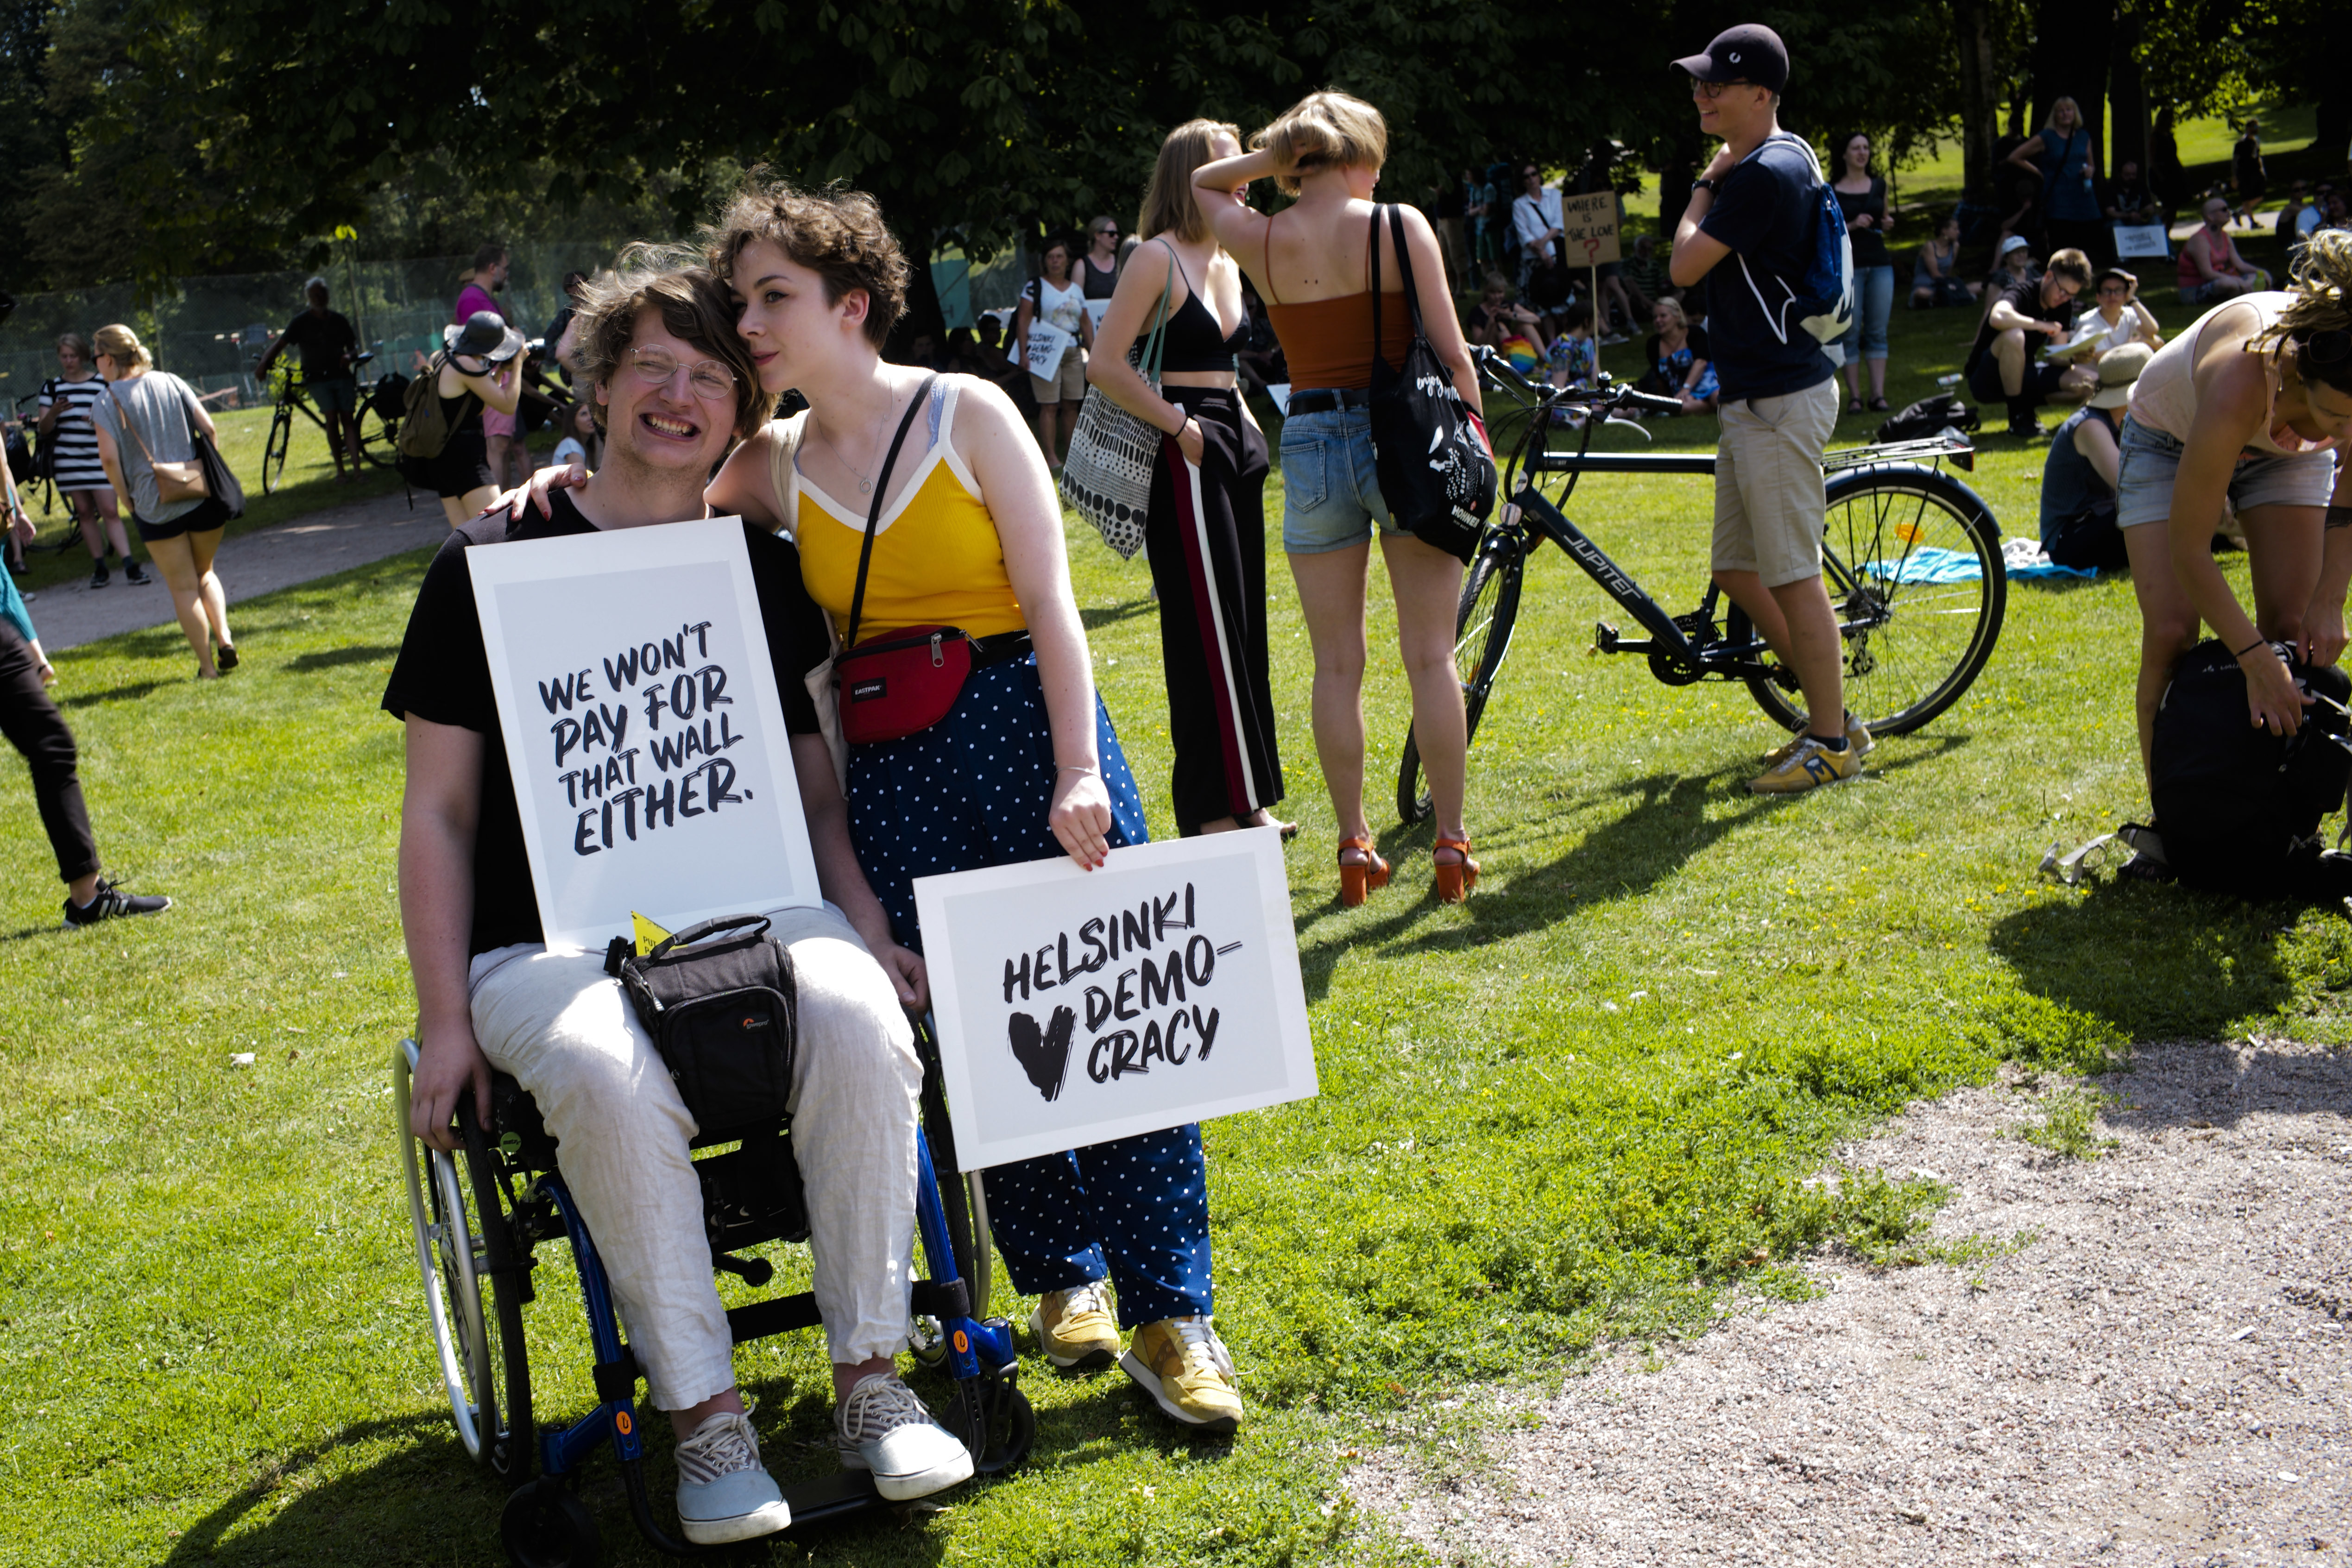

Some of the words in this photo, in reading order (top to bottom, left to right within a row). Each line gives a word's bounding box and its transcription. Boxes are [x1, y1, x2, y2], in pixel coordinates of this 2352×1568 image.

[1567, 196, 1607, 213] WHERE
[1567, 227, 1586, 242] THE
[1590, 223, 1614, 238] LOVE
[1583, 213, 1592, 222] IS
[1417, 372, 1444, 398] enjoy
[1451, 504, 1480, 528] HOHNER
[1563, 534, 1642, 600] JUPITER
[538, 668, 595, 715] WE
[604, 621, 712, 693] WON'T
[855, 685, 880, 695] EASTPAK
[551, 703, 628, 768] PAY
[643, 665, 733, 730] FOR
[559, 748, 640, 808] THAT
[650, 712, 744, 772] WALL
[574, 758, 753, 856] EITHER.
[643, 936, 656, 947] PUT
[1003, 882, 1195, 1004] HELSINKI
[1083, 934, 1243, 1033] DEMO-
[1087, 1004, 1220, 1084] CRACY
